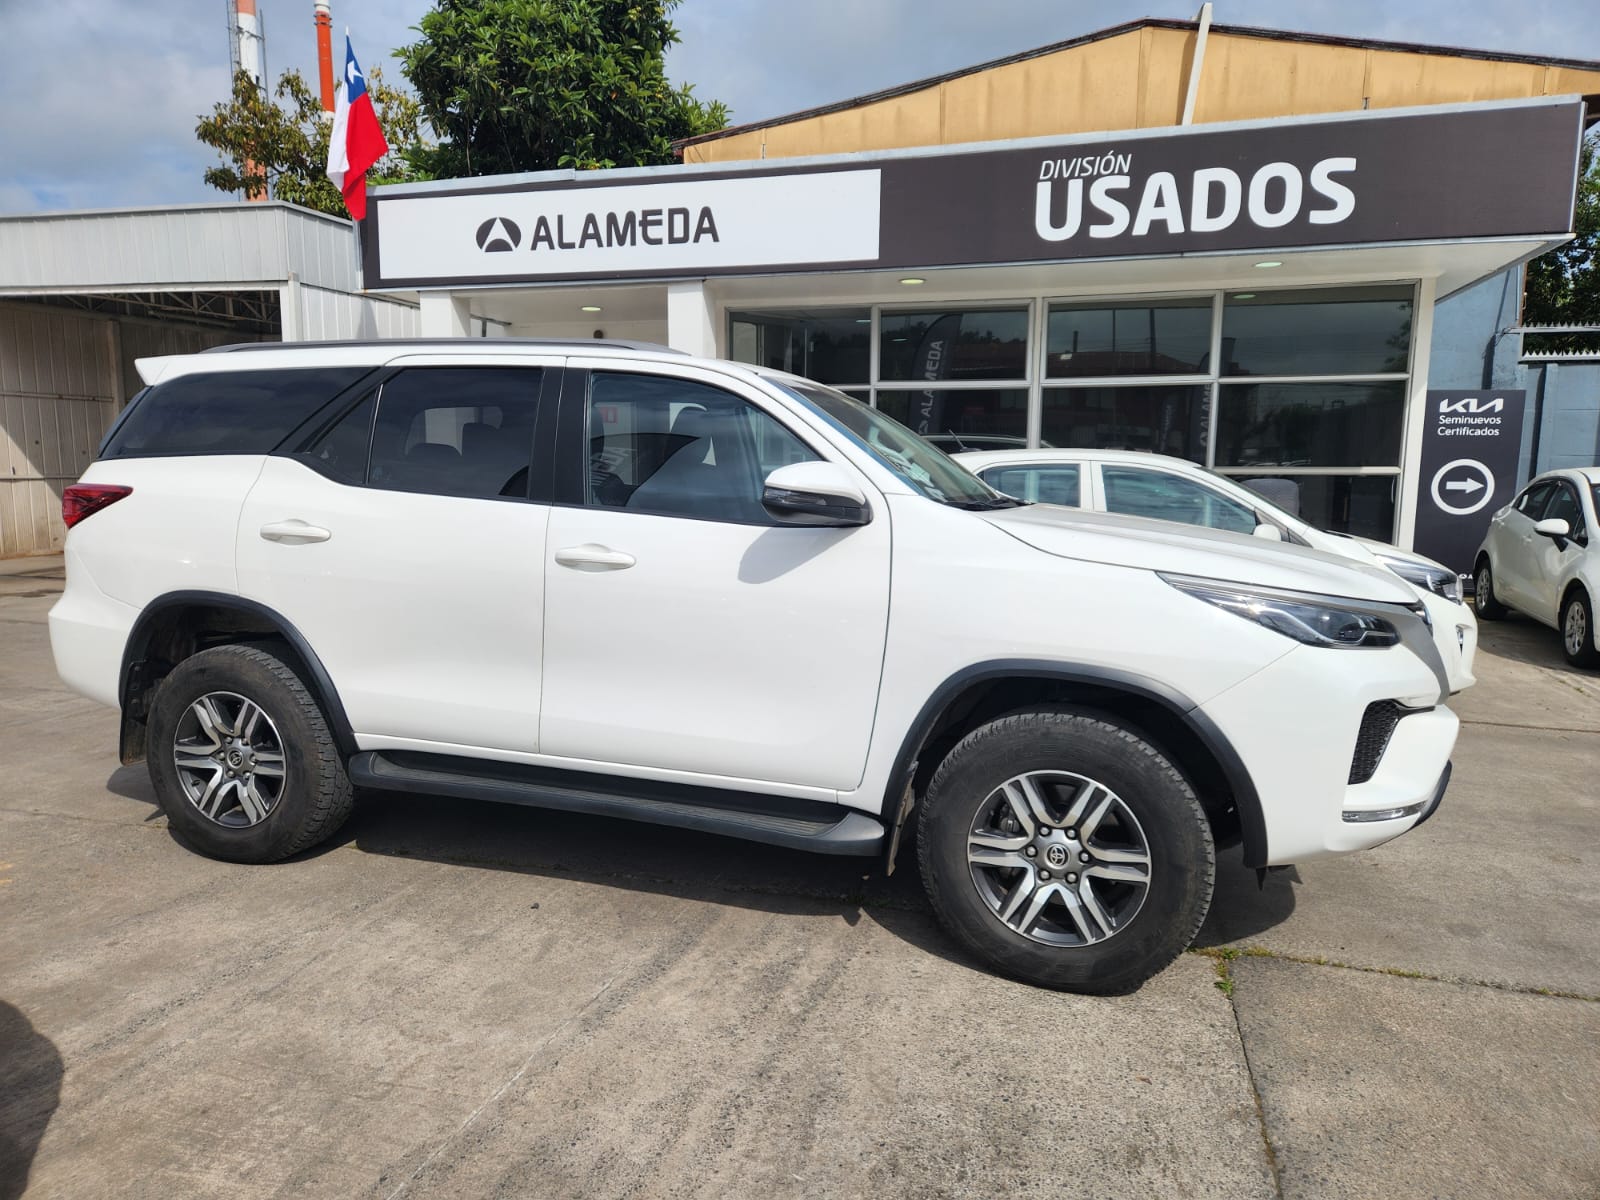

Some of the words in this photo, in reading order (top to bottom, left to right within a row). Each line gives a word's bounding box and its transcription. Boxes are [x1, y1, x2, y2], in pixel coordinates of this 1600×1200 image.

[1039, 150, 1132, 181] DIVISIÓN
[1035, 157, 1357, 241] USADOS
[530, 205, 720, 251] ALAMEDA
[1439, 398, 1504, 413] KIA
[1437, 426, 1500, 436] Certificados
[1438, 415, 1502, 425] Seminuevos
